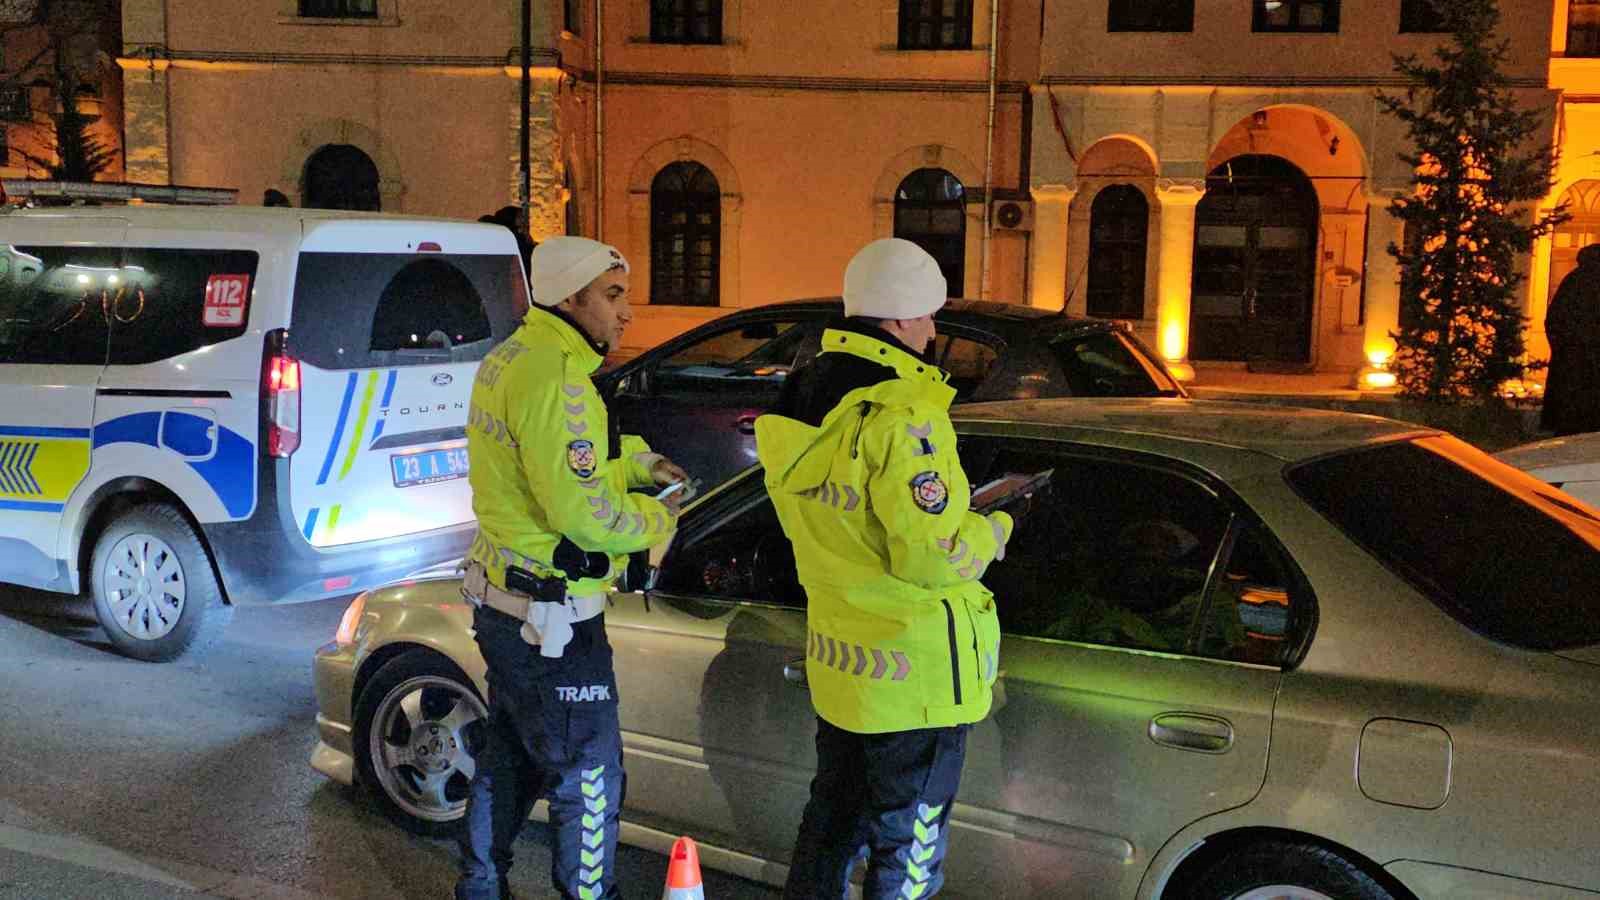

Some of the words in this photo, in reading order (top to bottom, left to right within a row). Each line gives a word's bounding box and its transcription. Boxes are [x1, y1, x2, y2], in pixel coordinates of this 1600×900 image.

[212, 279, 242, 304] 112
[380, 400, 464, 416] TOURN
[403, 456, 420, 479] 23
[430, 454, 440, 475] A
